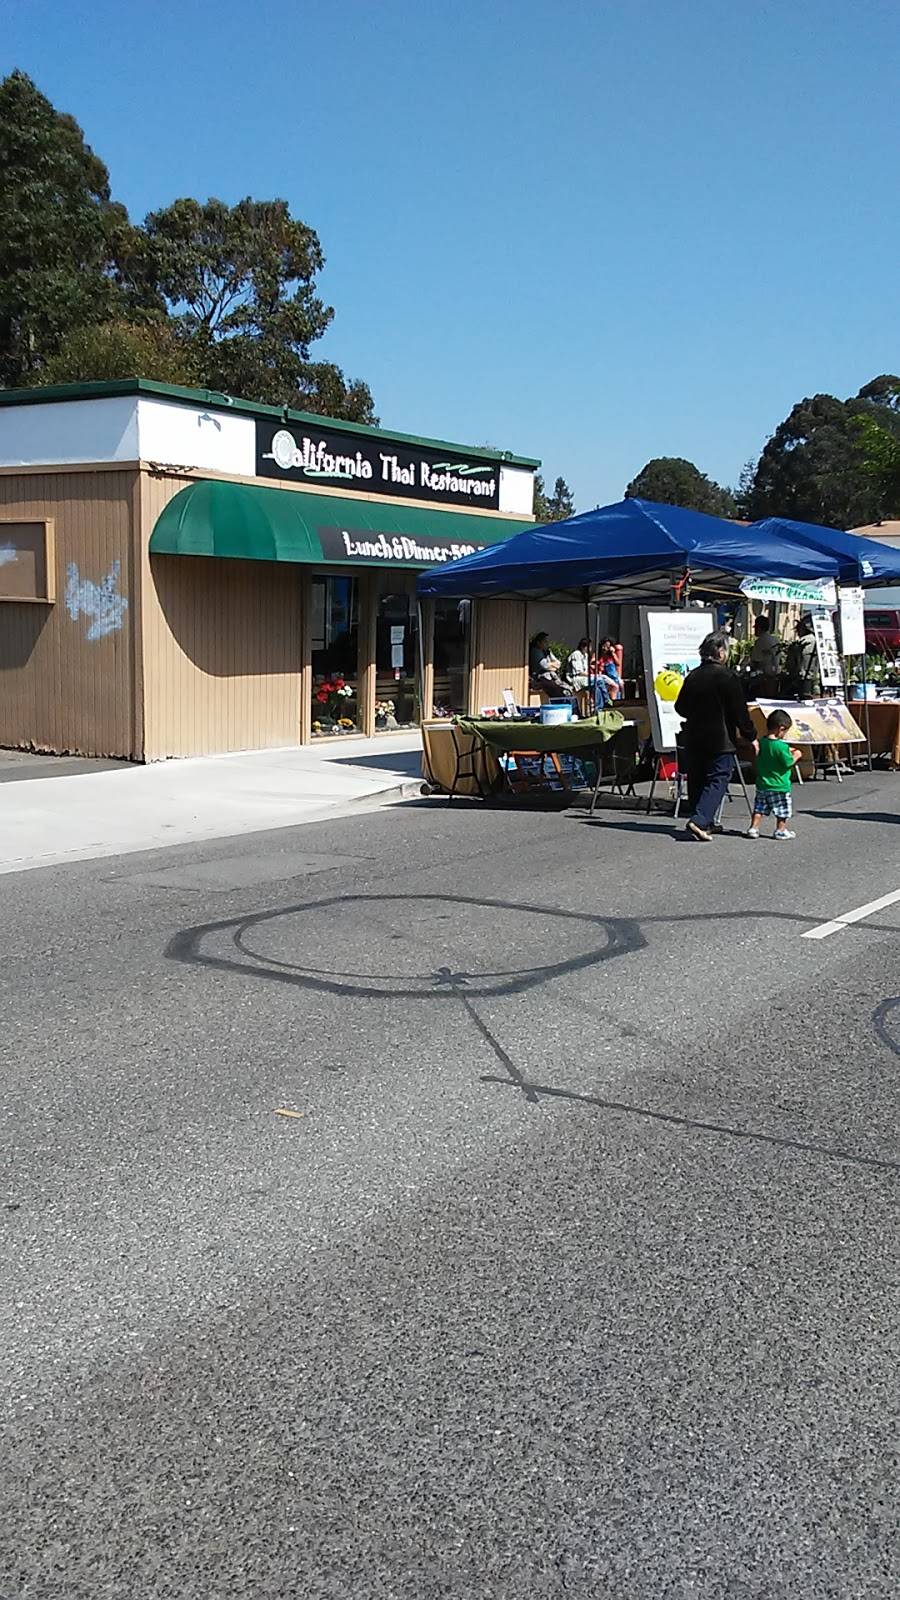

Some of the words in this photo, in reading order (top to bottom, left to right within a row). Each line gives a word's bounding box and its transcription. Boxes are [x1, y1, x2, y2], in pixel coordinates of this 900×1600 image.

[263, 430, 373, 478] California
[379, 453, 415, 486] Thai
[421, 461, 496, 497] Restaurant
